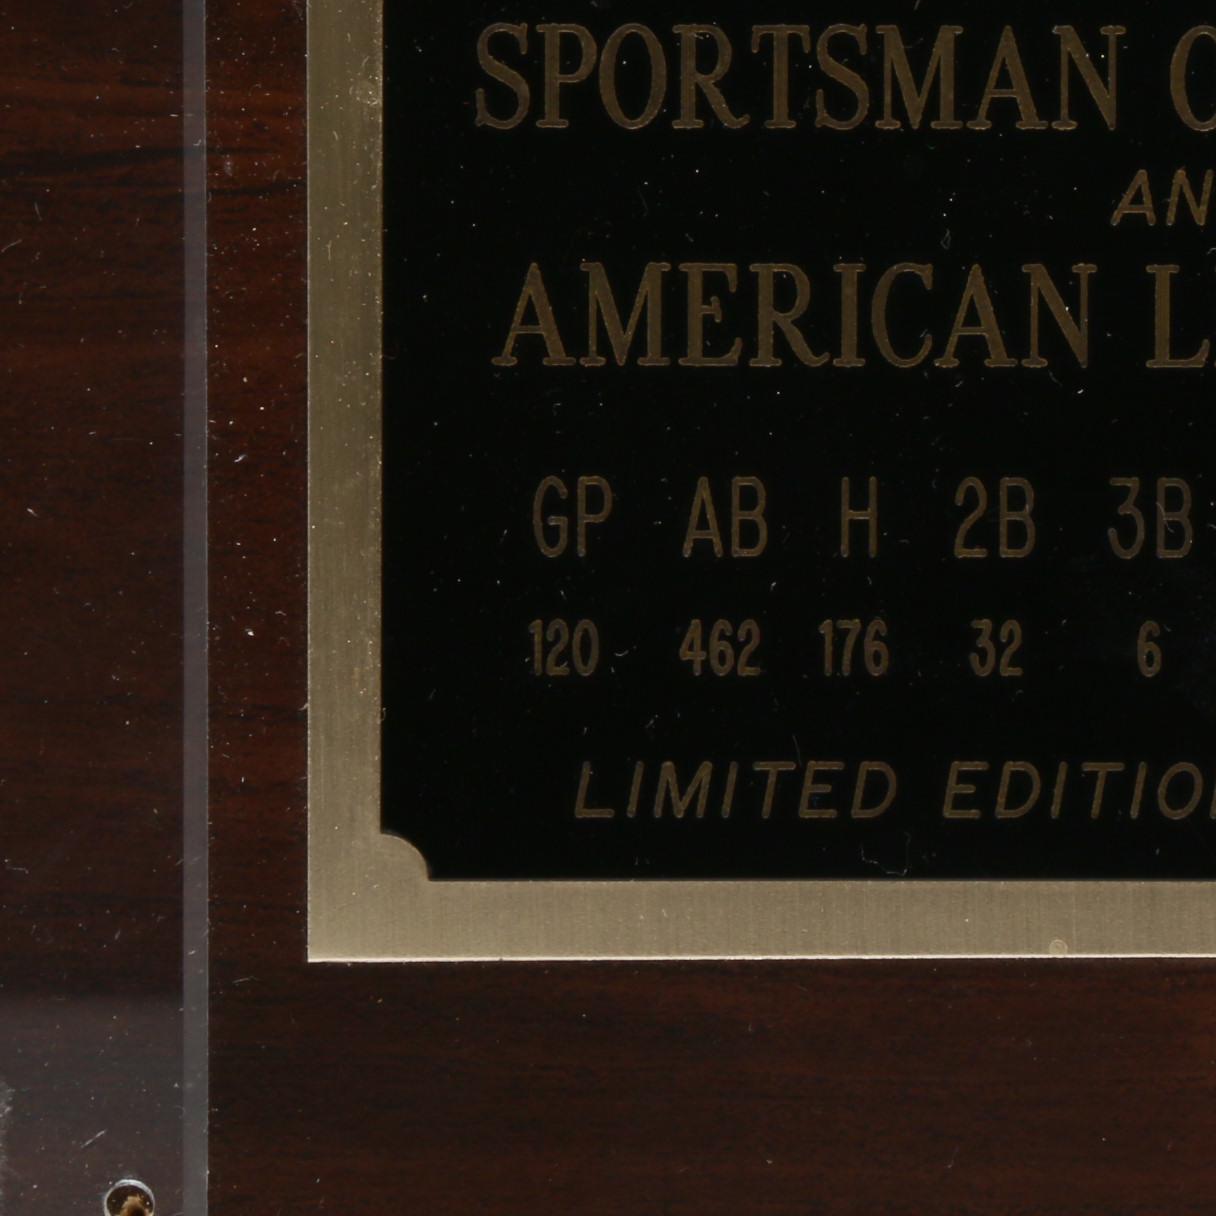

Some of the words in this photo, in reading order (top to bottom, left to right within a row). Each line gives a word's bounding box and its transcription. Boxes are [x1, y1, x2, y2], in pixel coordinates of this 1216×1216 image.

[475, 21, 1127, 132] SPORTSMAN
[491, 261, 1098, 369] AMERICAN
[532, 475, 613, 558] GP
[682, 475, 768, 558] AB
[840, 476, 878, 558] H
[954, 476, 1035, 559] 2B
[1107, 476, 1193, 560] 3B
[528, 618, 599, 677] 120
[679, 619, 762, 677] 462
[818, 618, 889, 677] 176
[969, 618, 1023, 677] 32
[1137, 620, 1162, 678] 6
[574, 760, 897, 819] LIMITED
